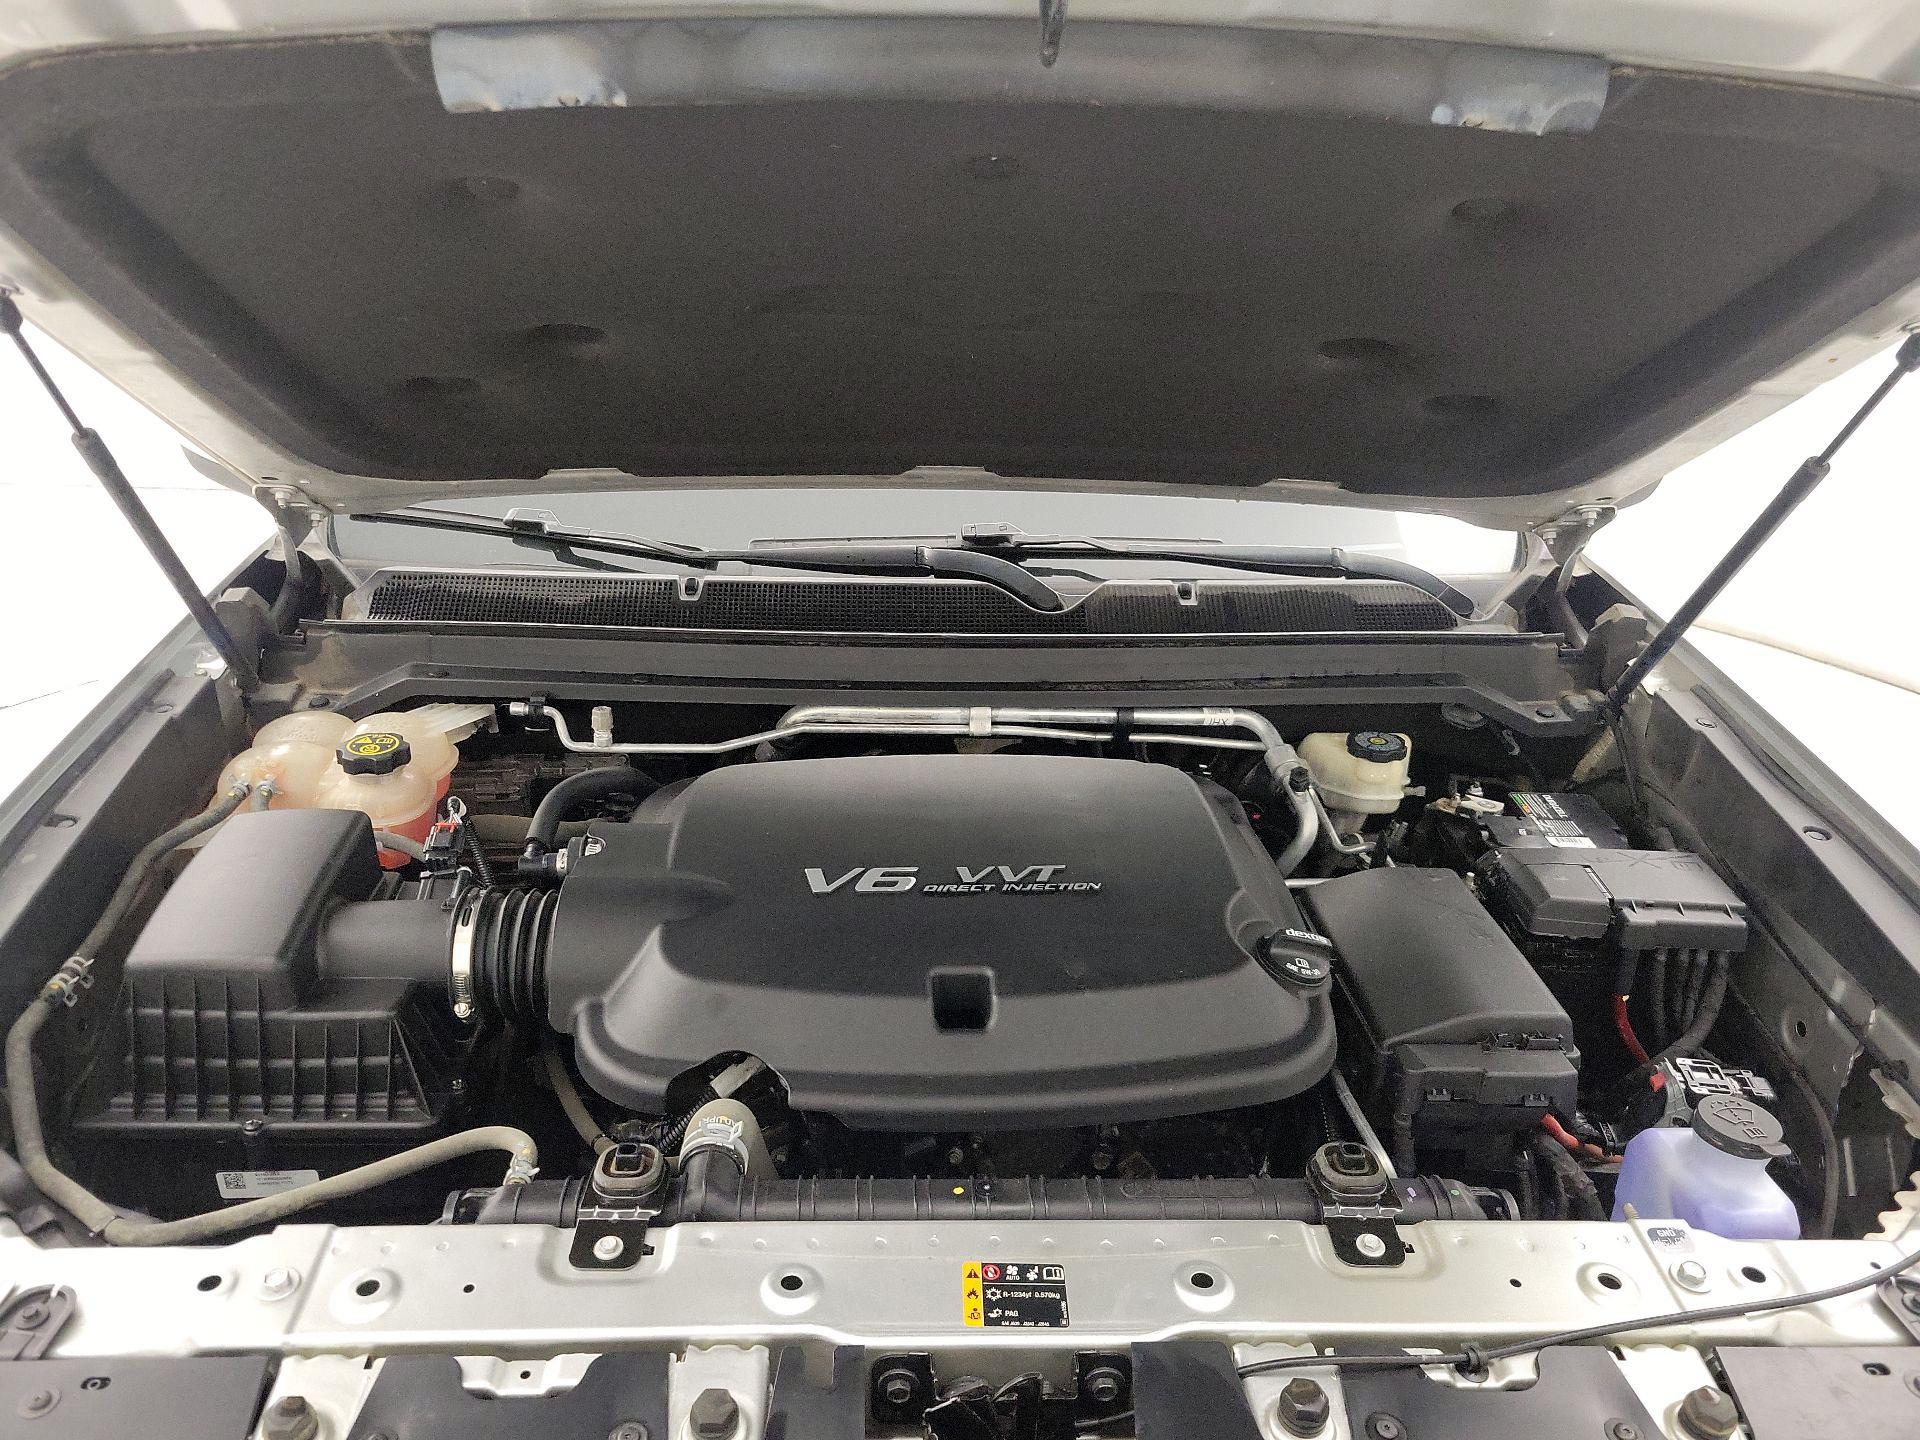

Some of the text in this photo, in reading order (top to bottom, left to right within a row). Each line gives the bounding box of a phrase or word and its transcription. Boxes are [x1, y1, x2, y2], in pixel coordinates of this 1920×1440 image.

[804, 866, 919, 893] V6
[956, 864, 1066, 883] VVT
[922, 882, 1102, 893] DIRECT INJECTION
[1002, 1291, 1032, 1299] R-1234yf
